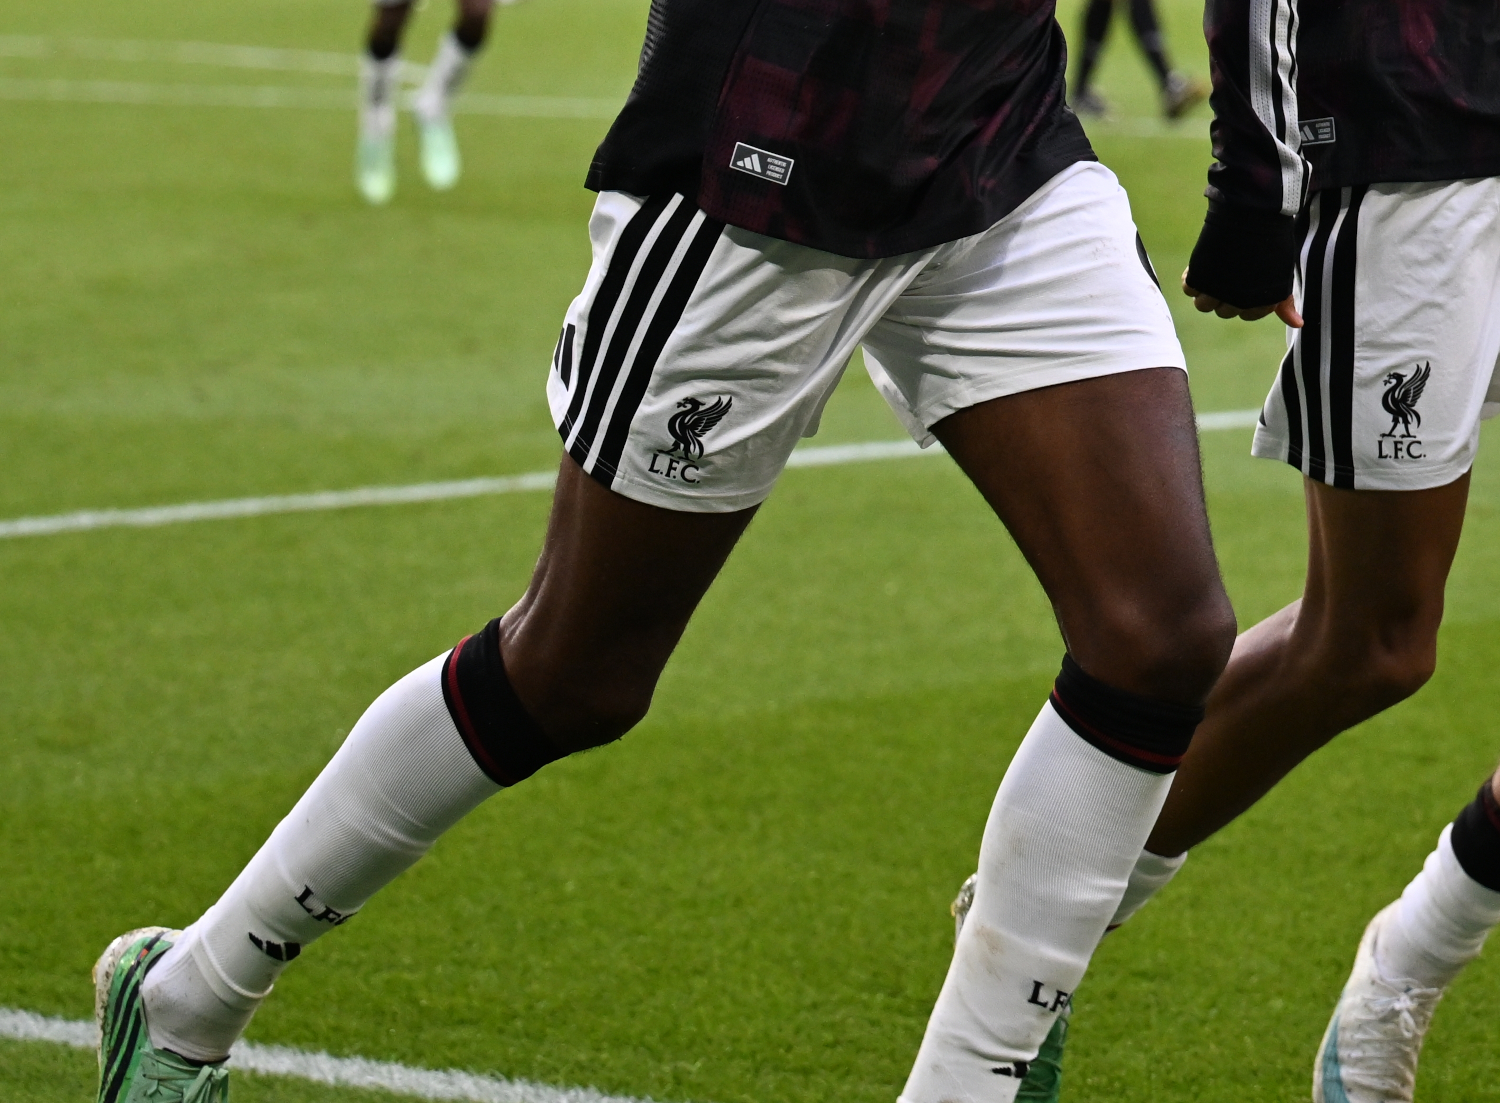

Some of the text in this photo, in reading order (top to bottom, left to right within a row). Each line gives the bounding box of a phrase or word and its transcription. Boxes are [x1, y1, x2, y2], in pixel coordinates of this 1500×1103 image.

[1377, 439, 1427, 460] L.F.C.
[647, 452, 701, 485] L.F.C.
[1027, 979, 1074, 1012] LF
